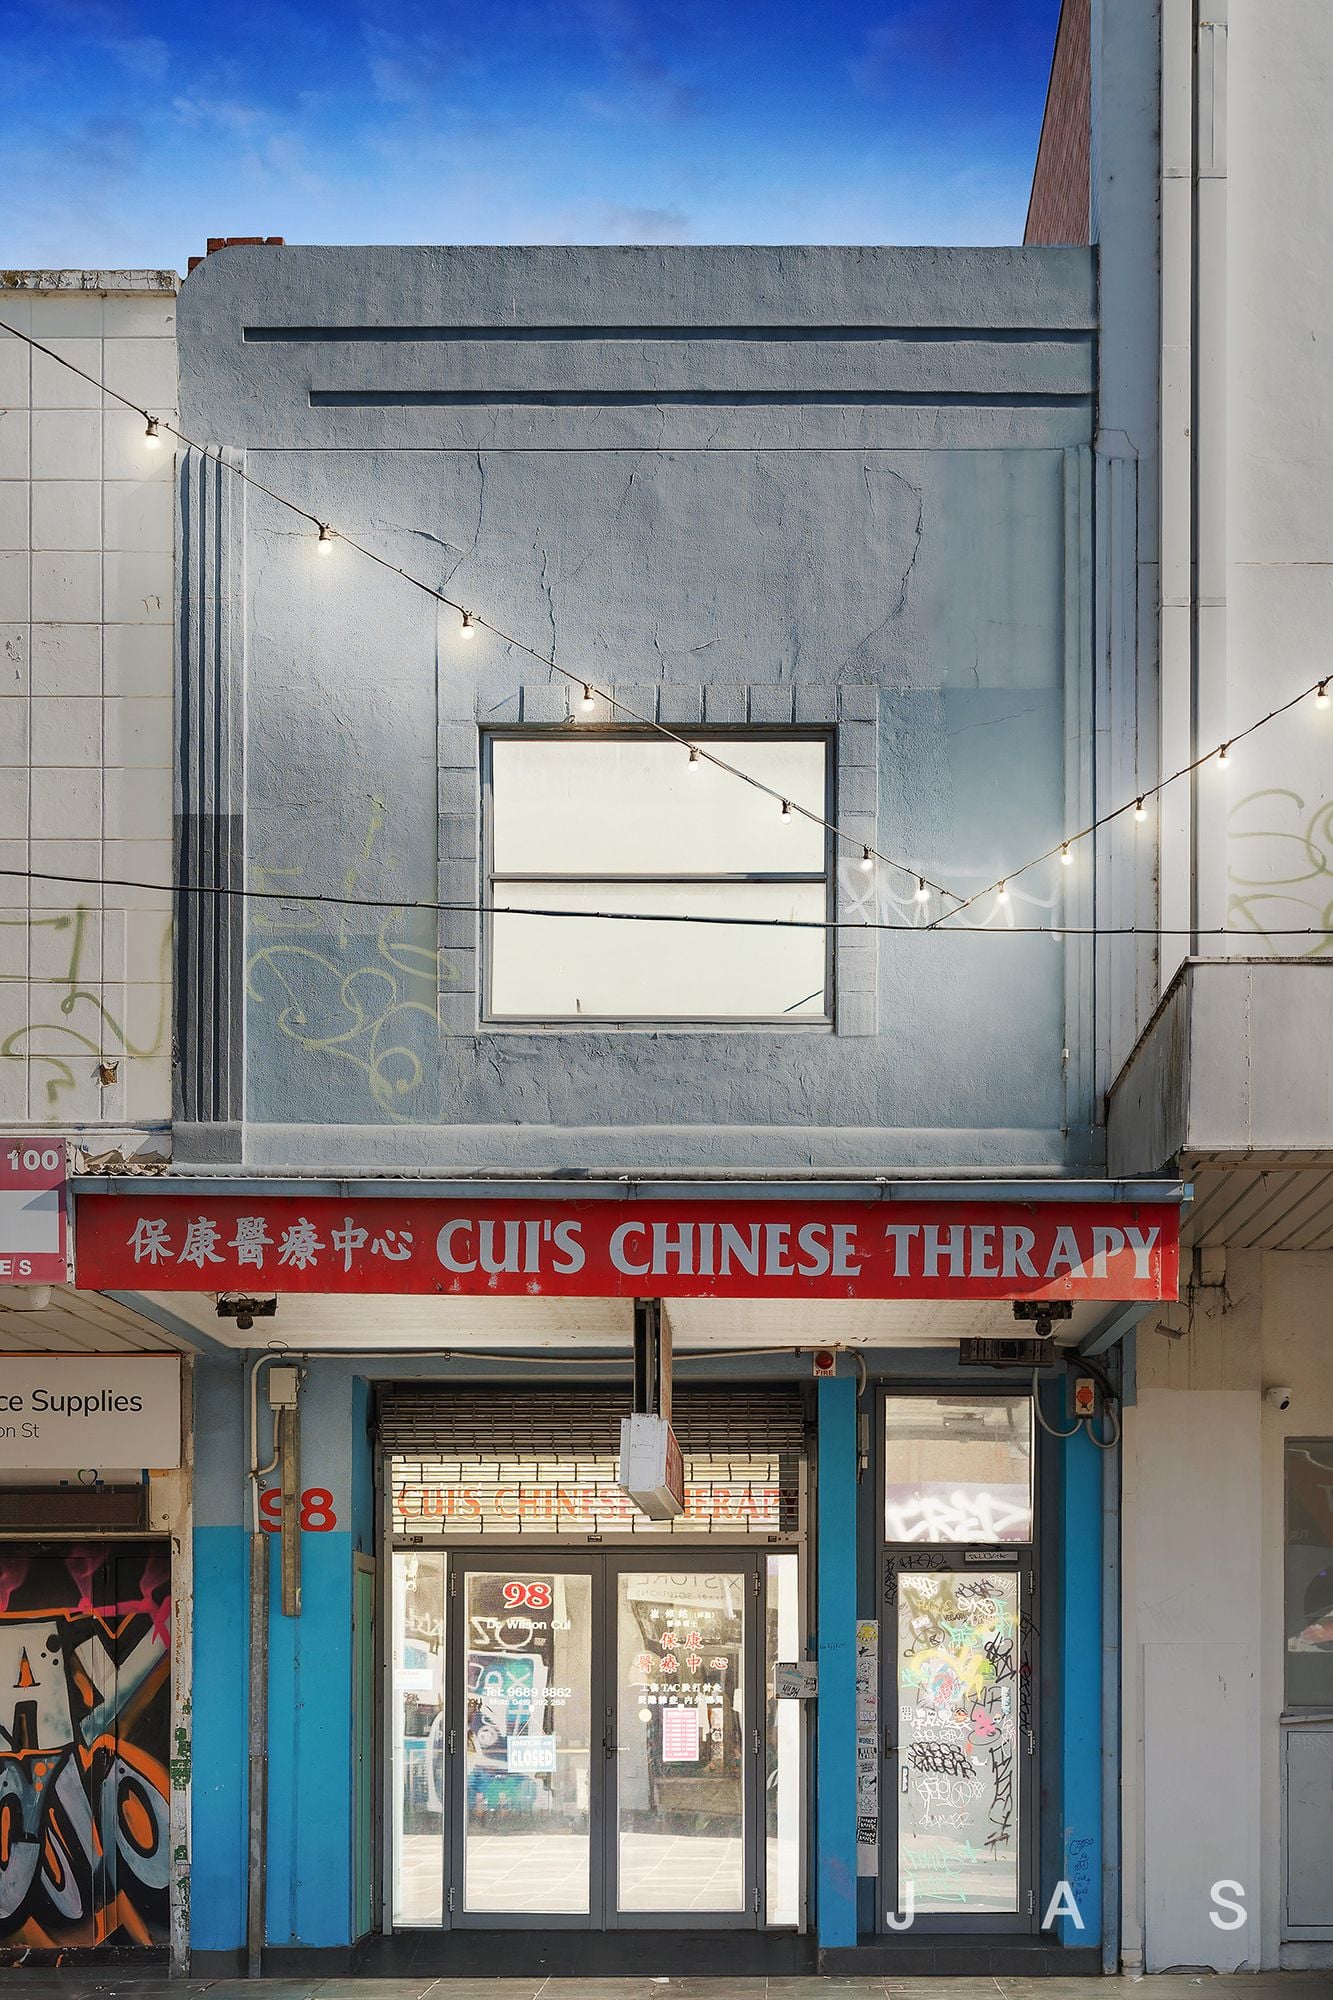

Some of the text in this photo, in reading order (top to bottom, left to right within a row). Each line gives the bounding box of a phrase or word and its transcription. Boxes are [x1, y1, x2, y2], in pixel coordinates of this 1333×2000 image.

[7, 1149, 59, 1171] 100
[126, 1215, 414, 1273] 保康醫療中心
[436, 1218, 1161, 1280] CUI'S CHINESE THERAPY
[31, 1389, 144, 1417] Supplies
[21, 1422, 40, 1439] St
[259, 1487, 337, 1533] 98
[502, 1581, 553, 1610] 98
[507, 1619, 547, 1630] Wilson
[551, 1619, 571, 1630] Cui
[659, 1631, 704, 1651] 保康
[635, 1653, 729, 1675] 醫療中心
[507, 1687, 538, 1698] 9689
[542, 1687, 572, 1698] 8862
[511, 1749, 553, 1768] CLOSED
